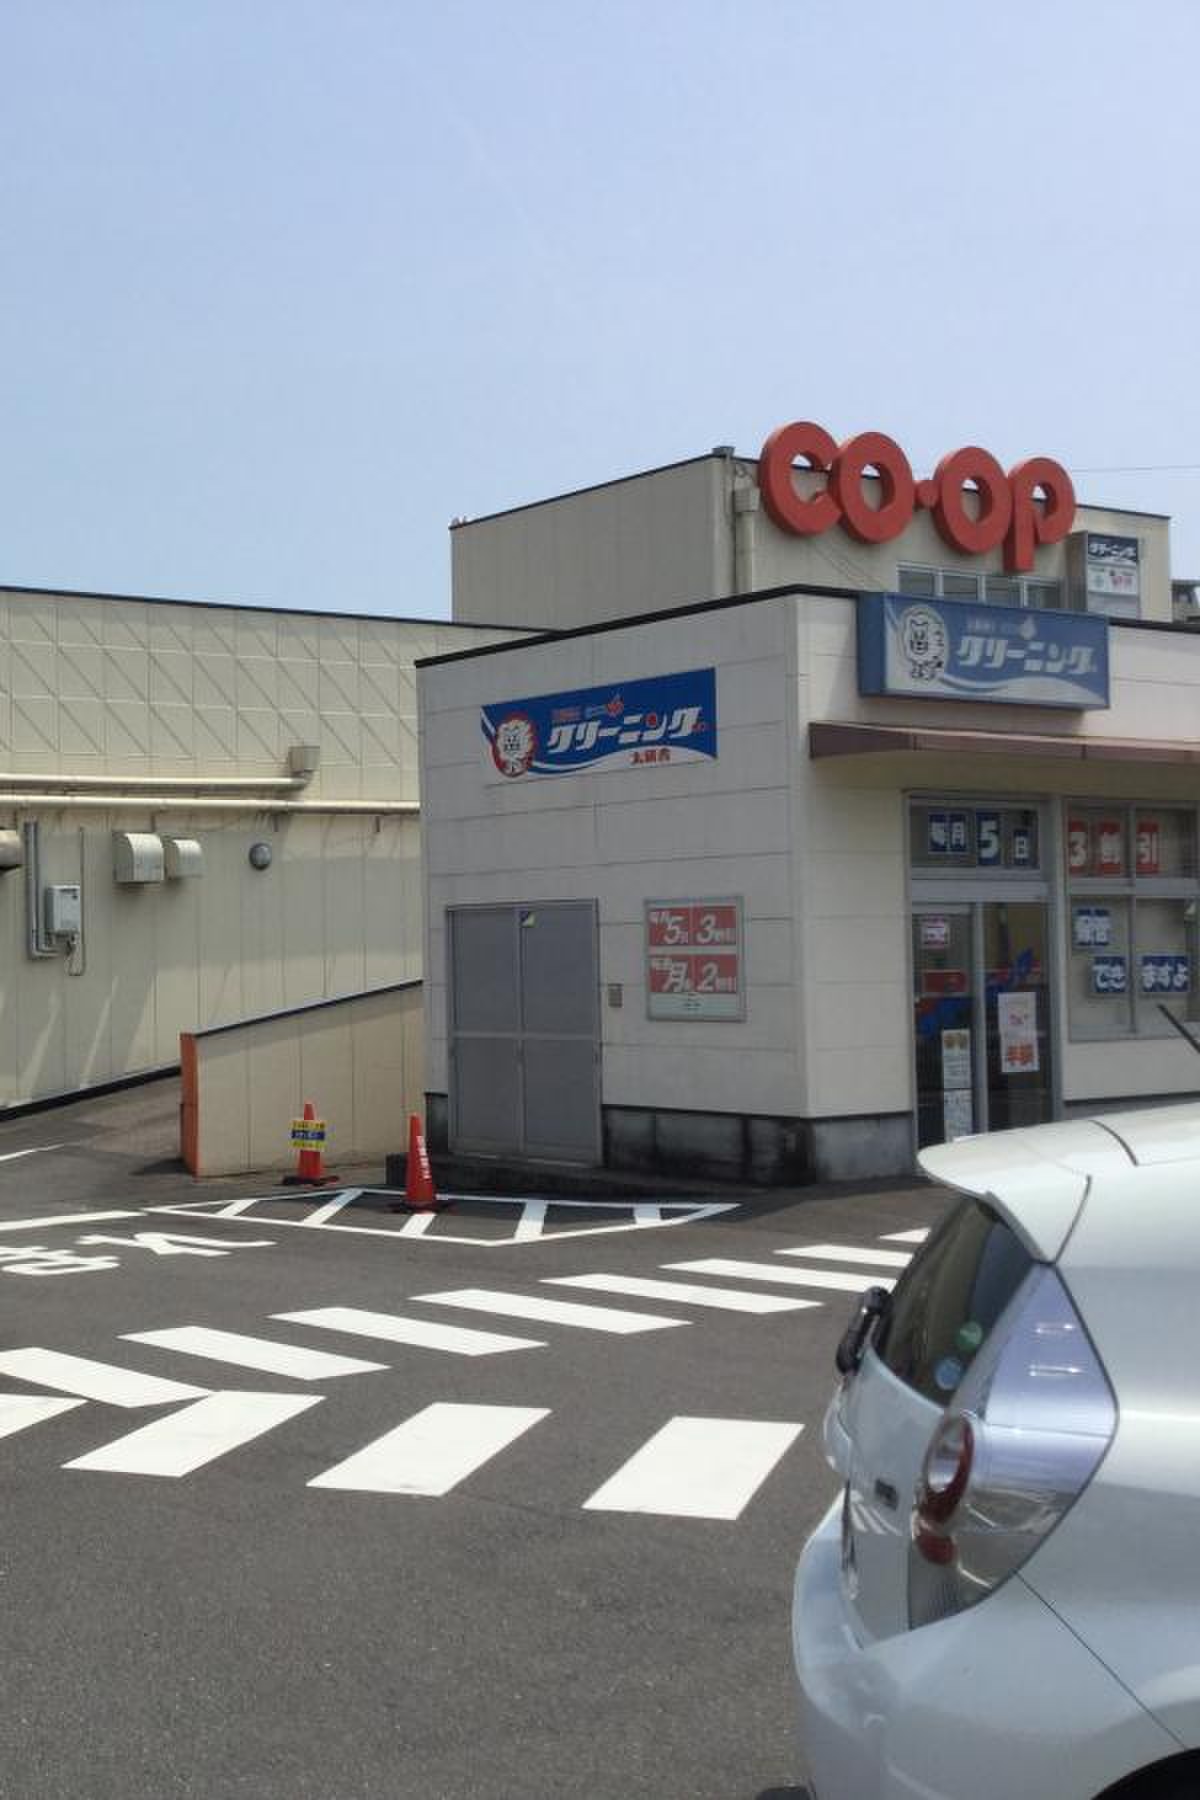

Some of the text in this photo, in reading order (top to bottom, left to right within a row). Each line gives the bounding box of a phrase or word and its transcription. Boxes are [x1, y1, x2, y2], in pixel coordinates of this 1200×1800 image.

[955, 635, 1097, 675] クリーニング
[547, 706, 703, 753] クリーニング
